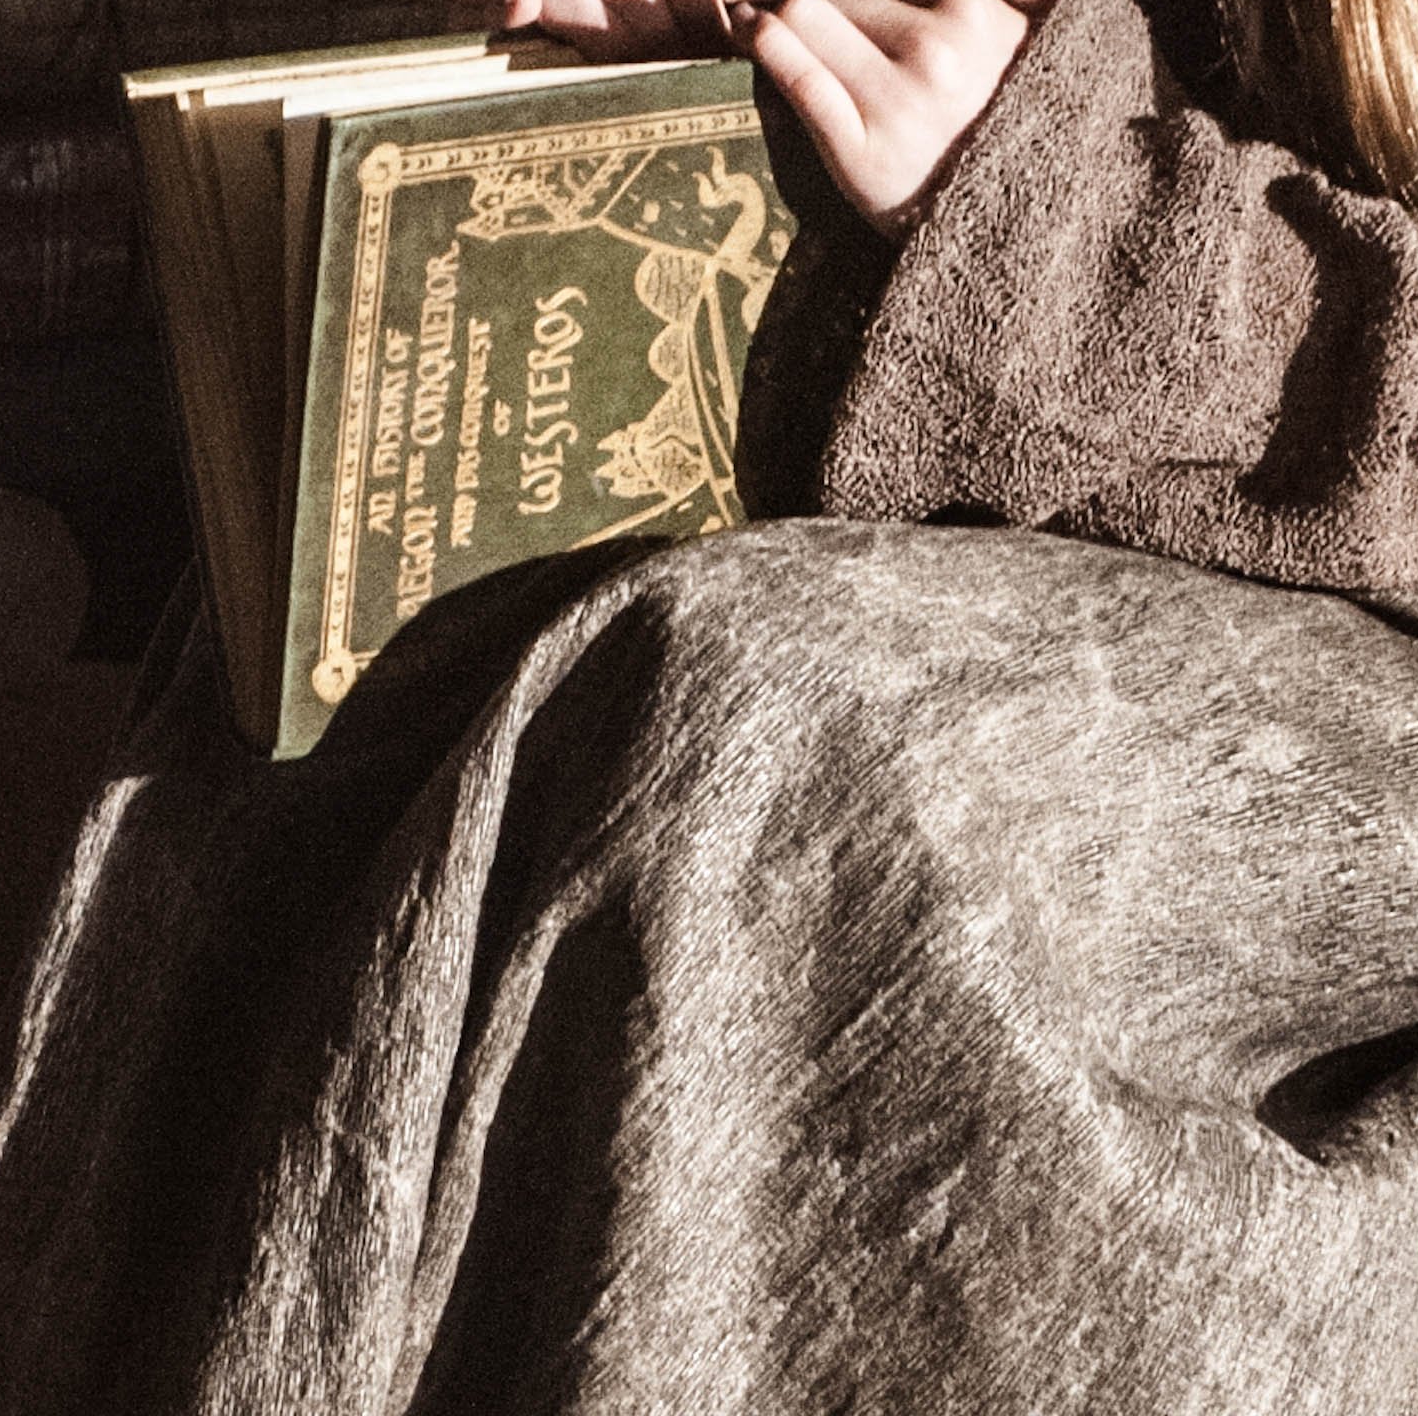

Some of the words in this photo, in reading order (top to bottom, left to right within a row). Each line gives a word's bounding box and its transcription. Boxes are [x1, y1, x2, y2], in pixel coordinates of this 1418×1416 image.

[385, 328, 414, 363] OF
[409, 239, 460, 446] CONQUEROR
[459, 317, 492, 447] CONQUEST
[517, 286, 588, 515] WESTEROS
[493, 398, 512, 437] OF
